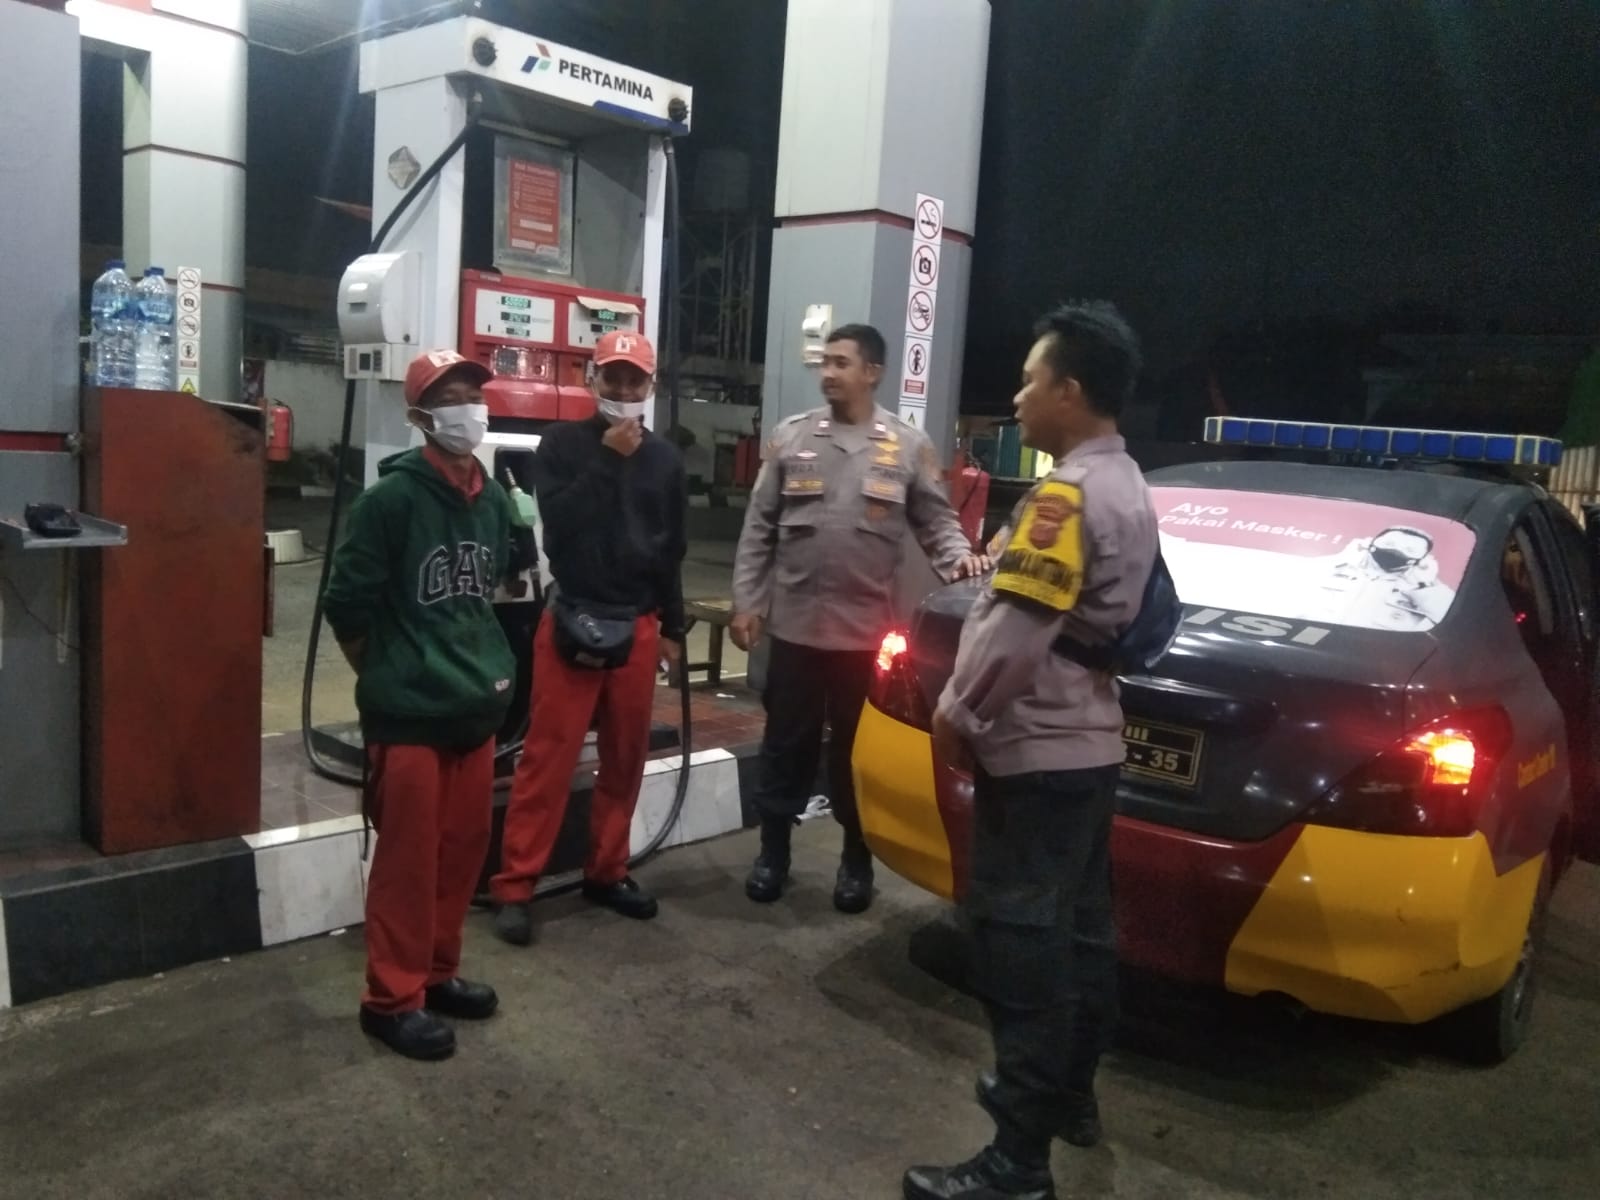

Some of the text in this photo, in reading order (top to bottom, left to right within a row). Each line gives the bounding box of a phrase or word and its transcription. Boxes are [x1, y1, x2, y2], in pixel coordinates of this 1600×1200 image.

[559, 59, 653, 101] PERTAMINA
[1170, 502, 1229, 516] Ayo
[1158, 515, 1228, 528] Pakai
[1230, 519, 1328, 541] Masker
[1149, 750, 1179, 771] 35
